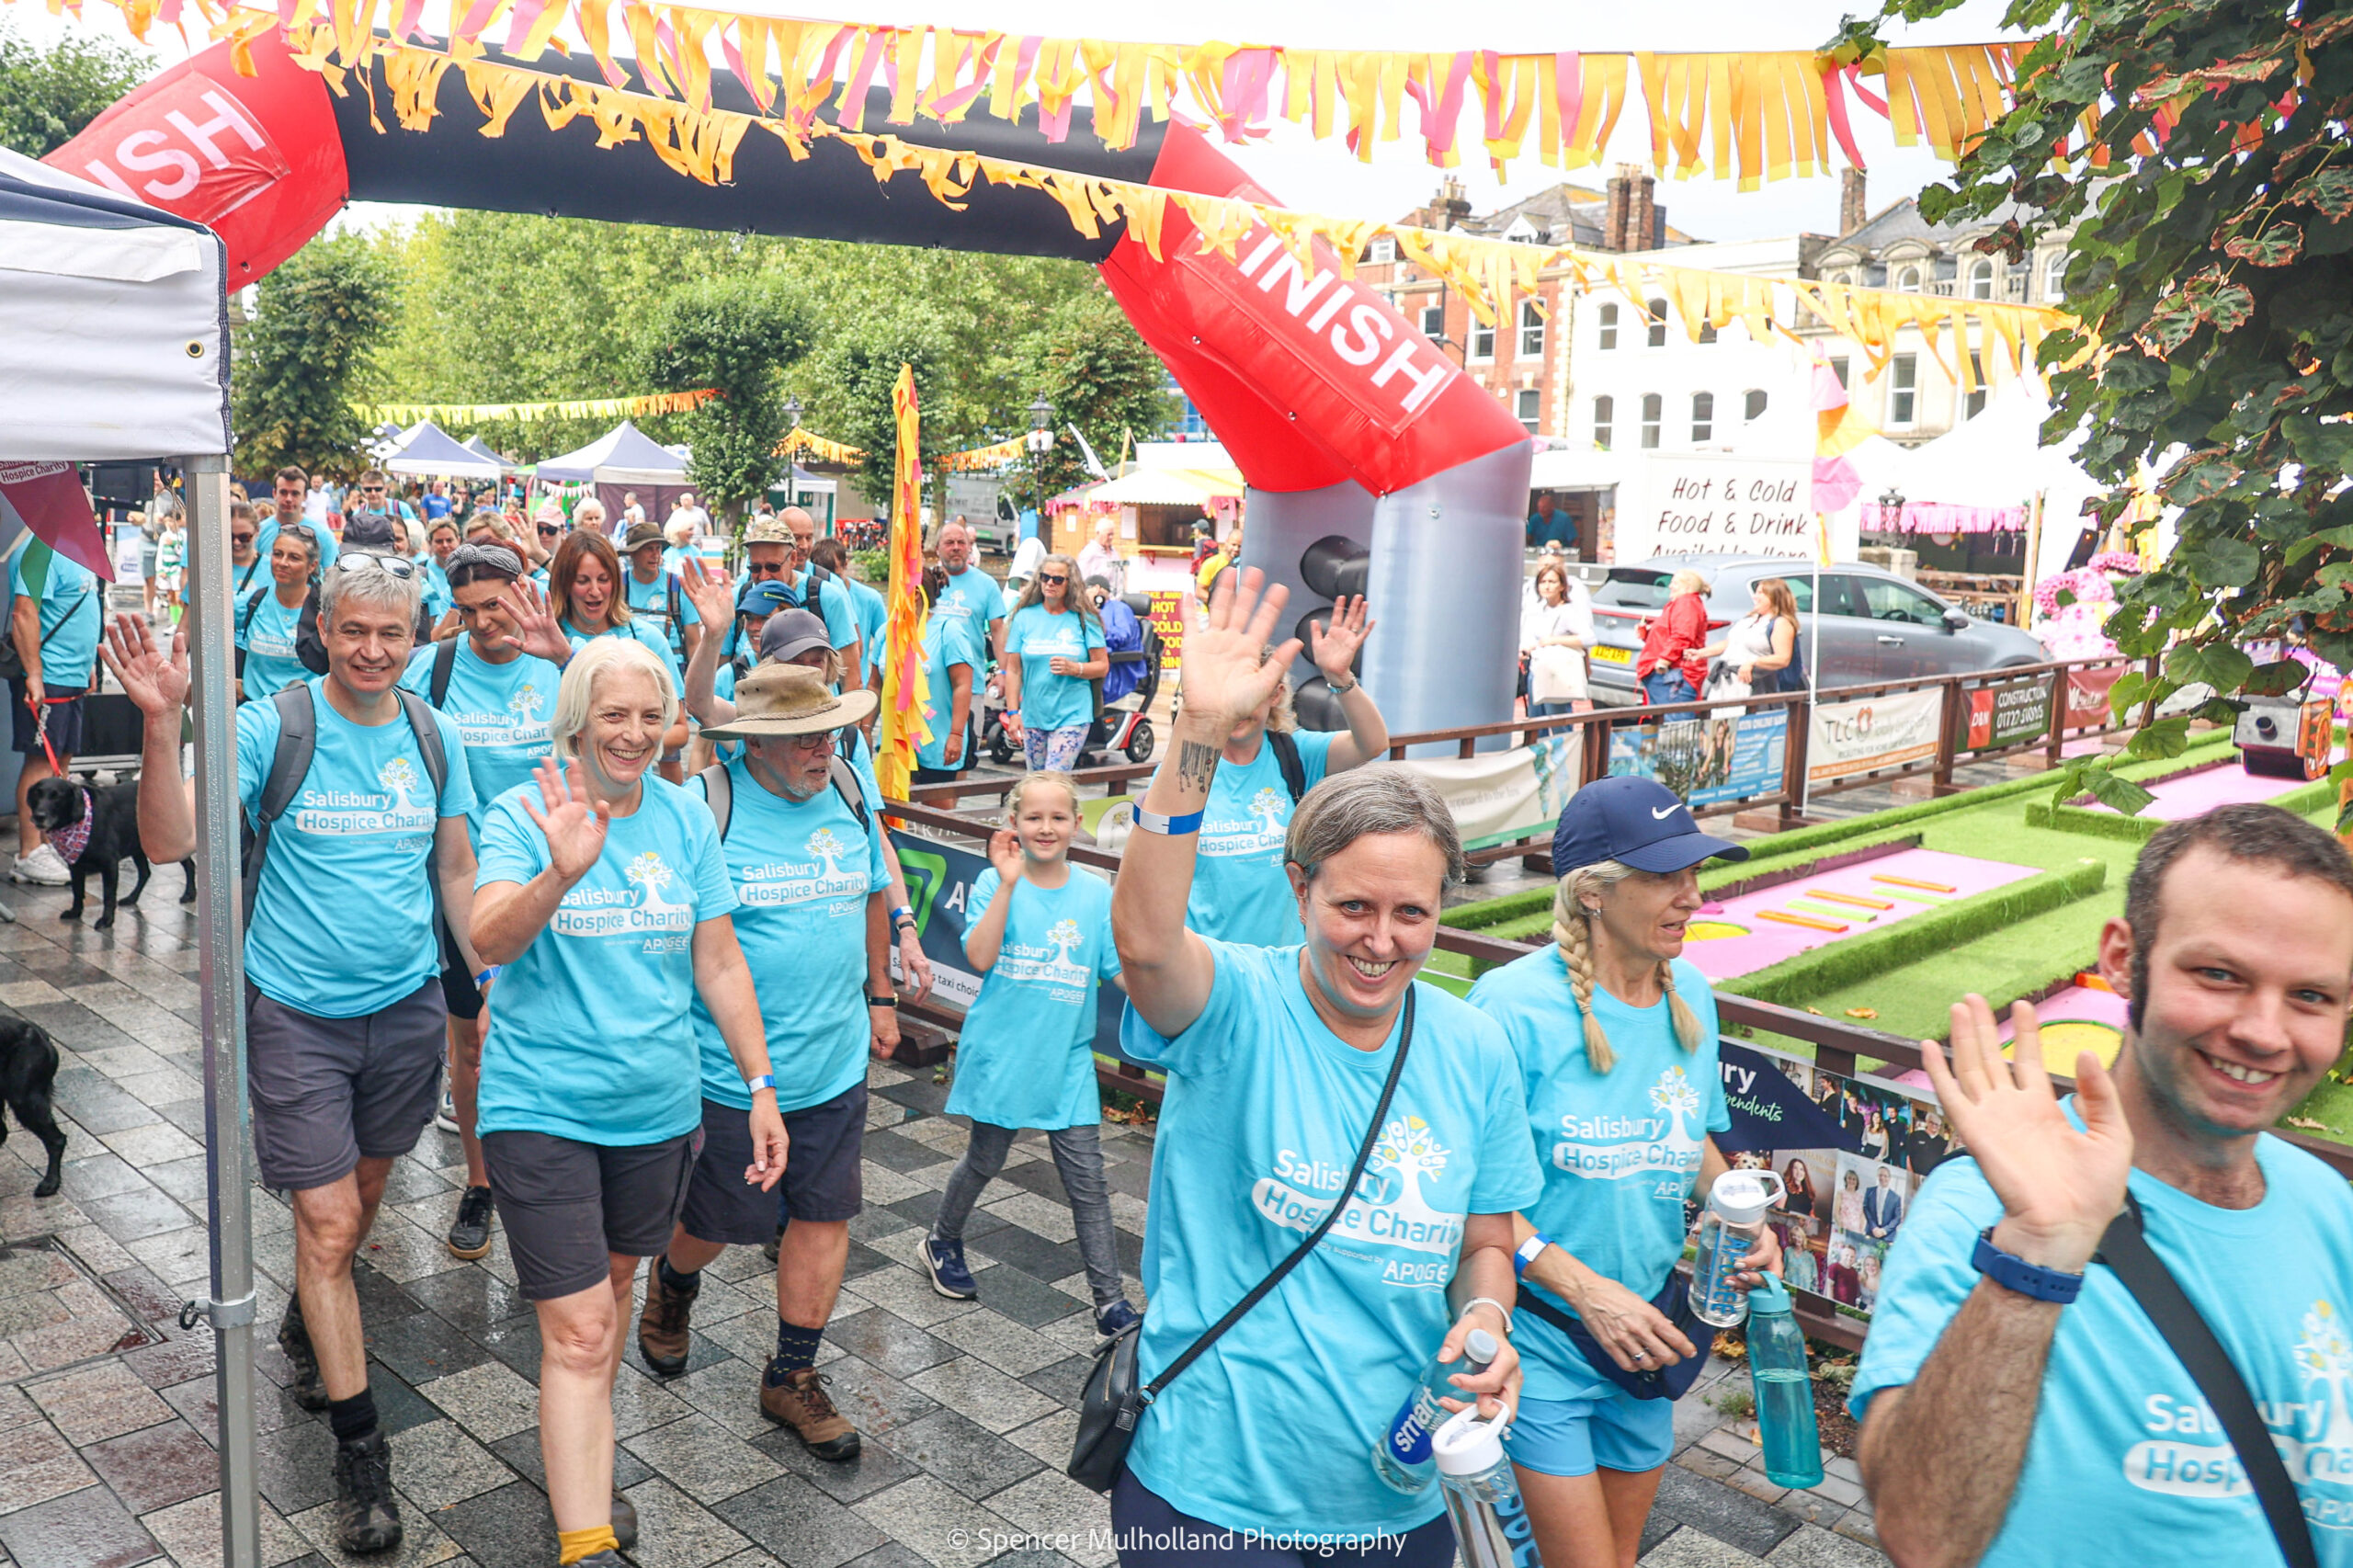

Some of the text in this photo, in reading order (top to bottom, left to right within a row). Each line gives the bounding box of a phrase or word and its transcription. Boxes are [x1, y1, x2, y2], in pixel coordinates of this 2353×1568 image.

[85, 90, 267, 204] ISH
[1198, 204, 1447, 414] INISH
[1, 460, 67, 483] Hospice Charity
[1672, 478, 1797, 502] Hot & Cold
[1657, 511, 1807, 535] Food & Drink
[1151, 601, 1176, 613] HOT
[1158, 636, 1184, 649] OD
[1160, 655, 1182, 669] RIN
[454, 712, 520, 727] Salisbury
[1825, 718, 1854, 744] TLC
[513, 727, 551, 741] Char
[528, 744, 553, 756] APO
[302, 790, 392, 811] Salisbury
[303, 812, 378, 834] Hospice
[1199, 819, 1263, 834] Salisbury
[1199, 836, 1255, 853] Hospice
[742, 862, 821, 881] Salisbury
[559, 887, 640, 907] Salisbury
[745, 875, 866, 903] Hospice Charity
[557, 907, 691, 934] Hospice Charity
[1000, 942, 1055, 961] alsbury
[938, 974, 982, 998] taxi choic
[1724, 1095, 1783, 1122] pendents
[1561, 1114, 1665, 1140] Salisbury
[1564, 1144, 1700, 1176] Hospice Char
[1272, 1148, 1392, 1202] Salisry
[1263, 1185, 1362, 1230] Hospe
[1334, 1246, 1373, 1262] supported
[1382, 1260, 1449, 1283] APOGE
[1394, 1385, 1440, 1452] smart
[2145, 1392, 2325, 1438] Salury
[2144, 1446, 2286, 1492] Hosp
